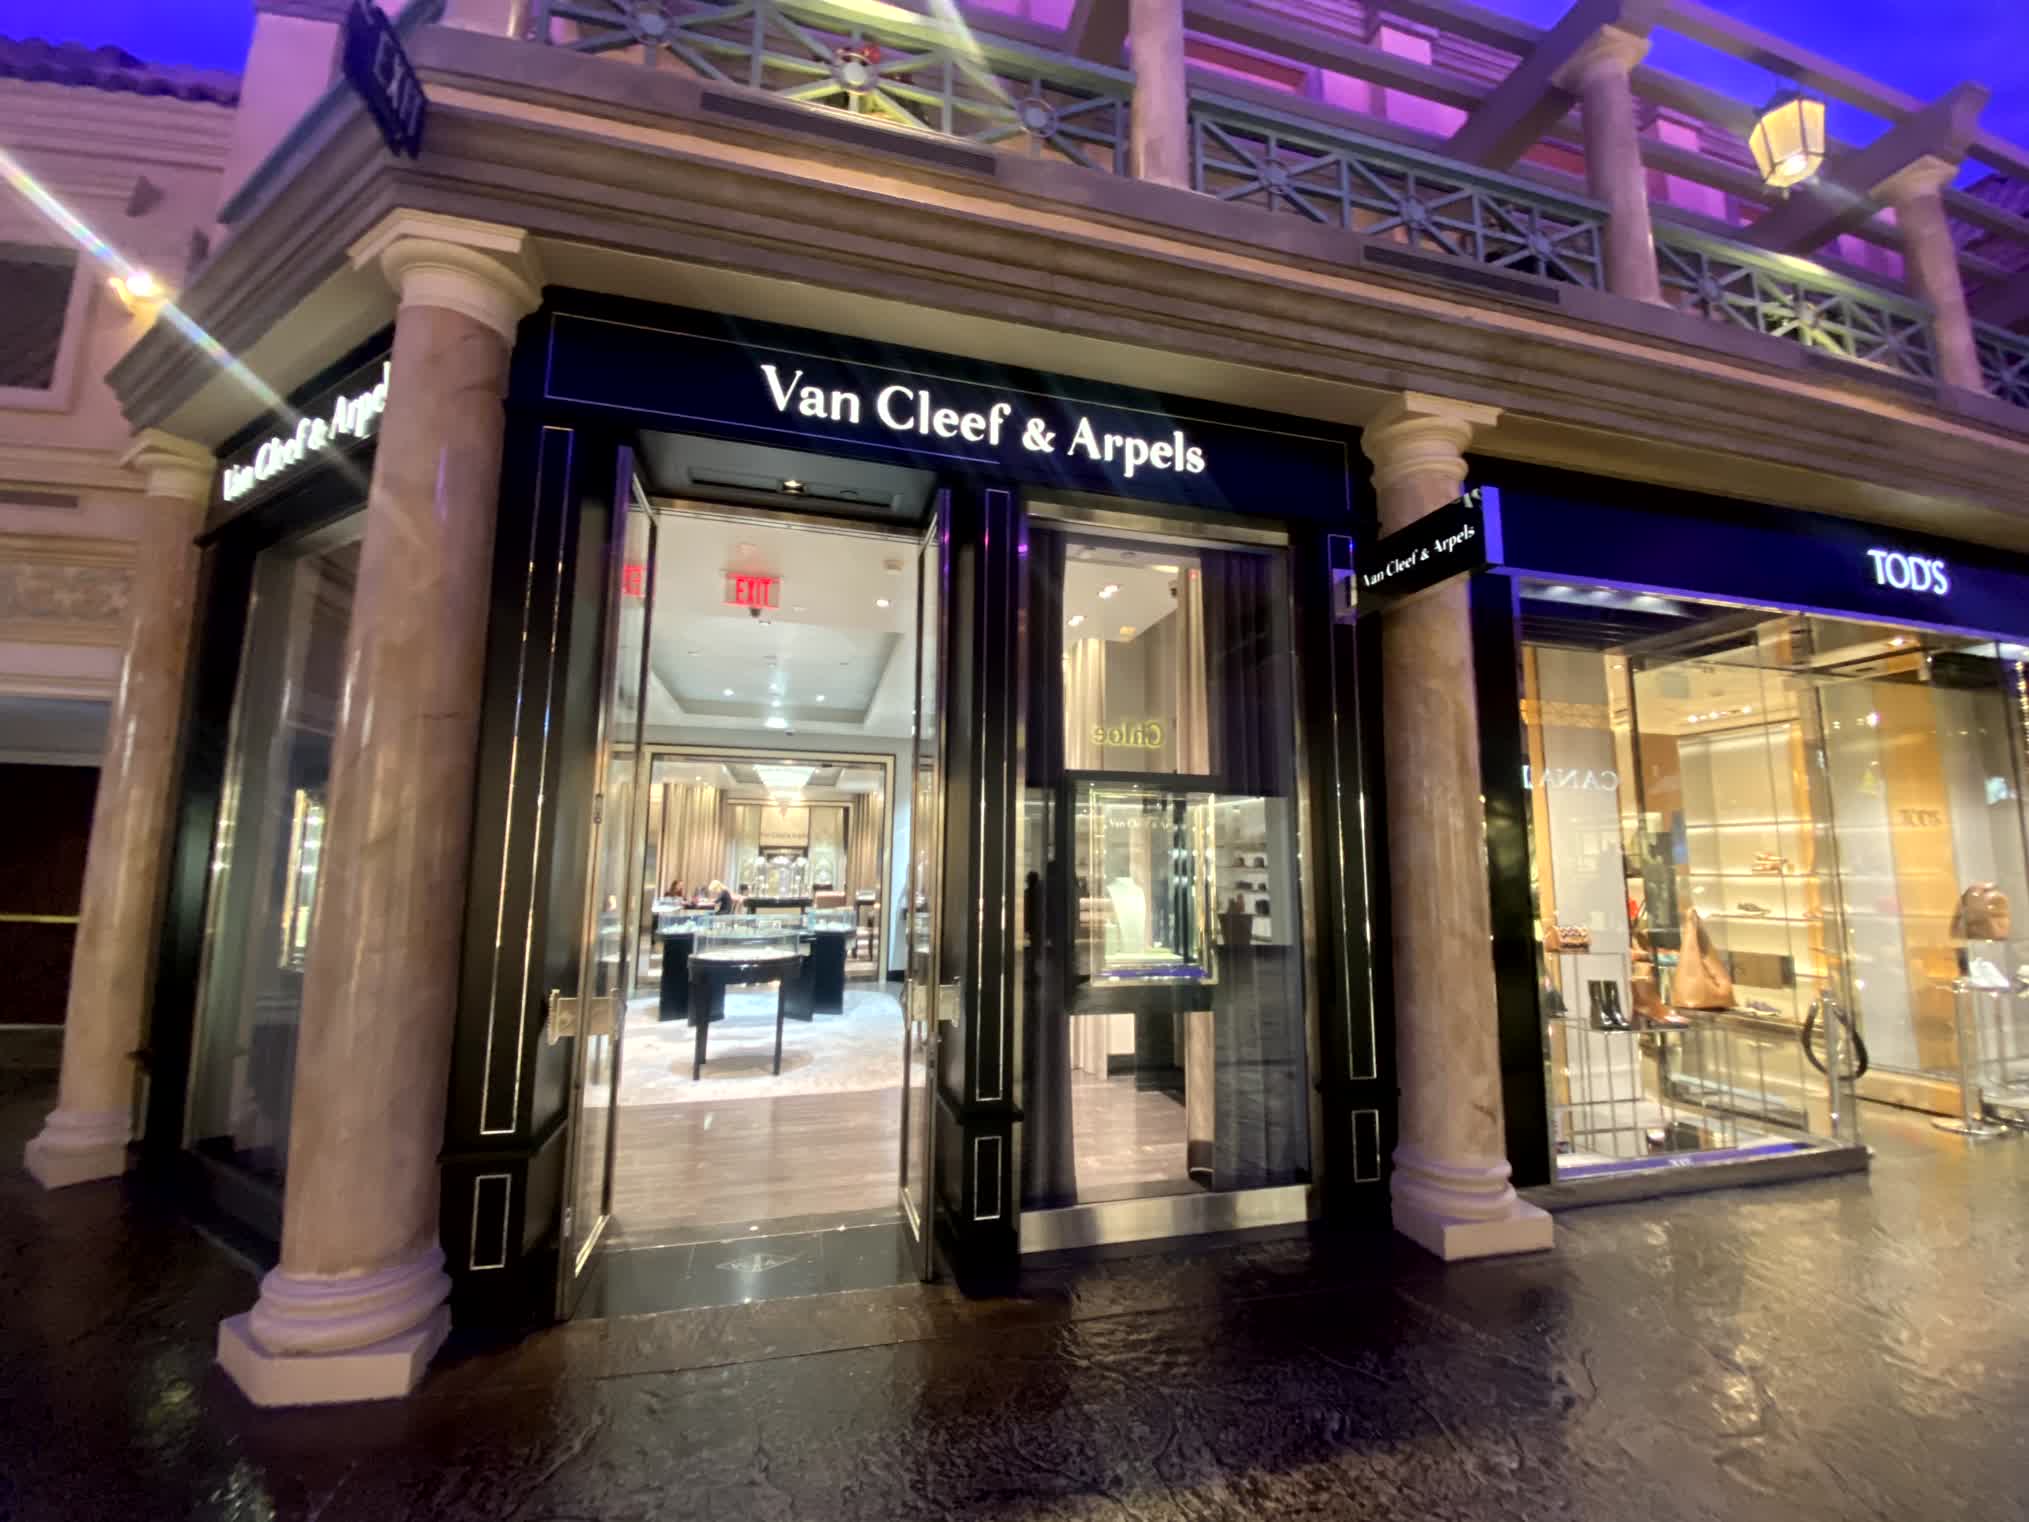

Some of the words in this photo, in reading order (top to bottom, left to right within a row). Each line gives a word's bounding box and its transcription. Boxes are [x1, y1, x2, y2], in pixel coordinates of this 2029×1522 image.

[760, 364, 860, 424] Van
[876, 385, 1012, 446] Cleef
[1022, 417, 1057, 453] &
[1067, 416, 1206, 479] Arpels
[1363, 572, 1385, 587] Van
[1385, 548, 1419, 577] Cleef
[1420, 547, 1430, 561] &
[1433, 523, 1476, 553] Arpels
[1867, 548, 1950, 596] TOD'S
[735, 577, 773, 606] EXIT
